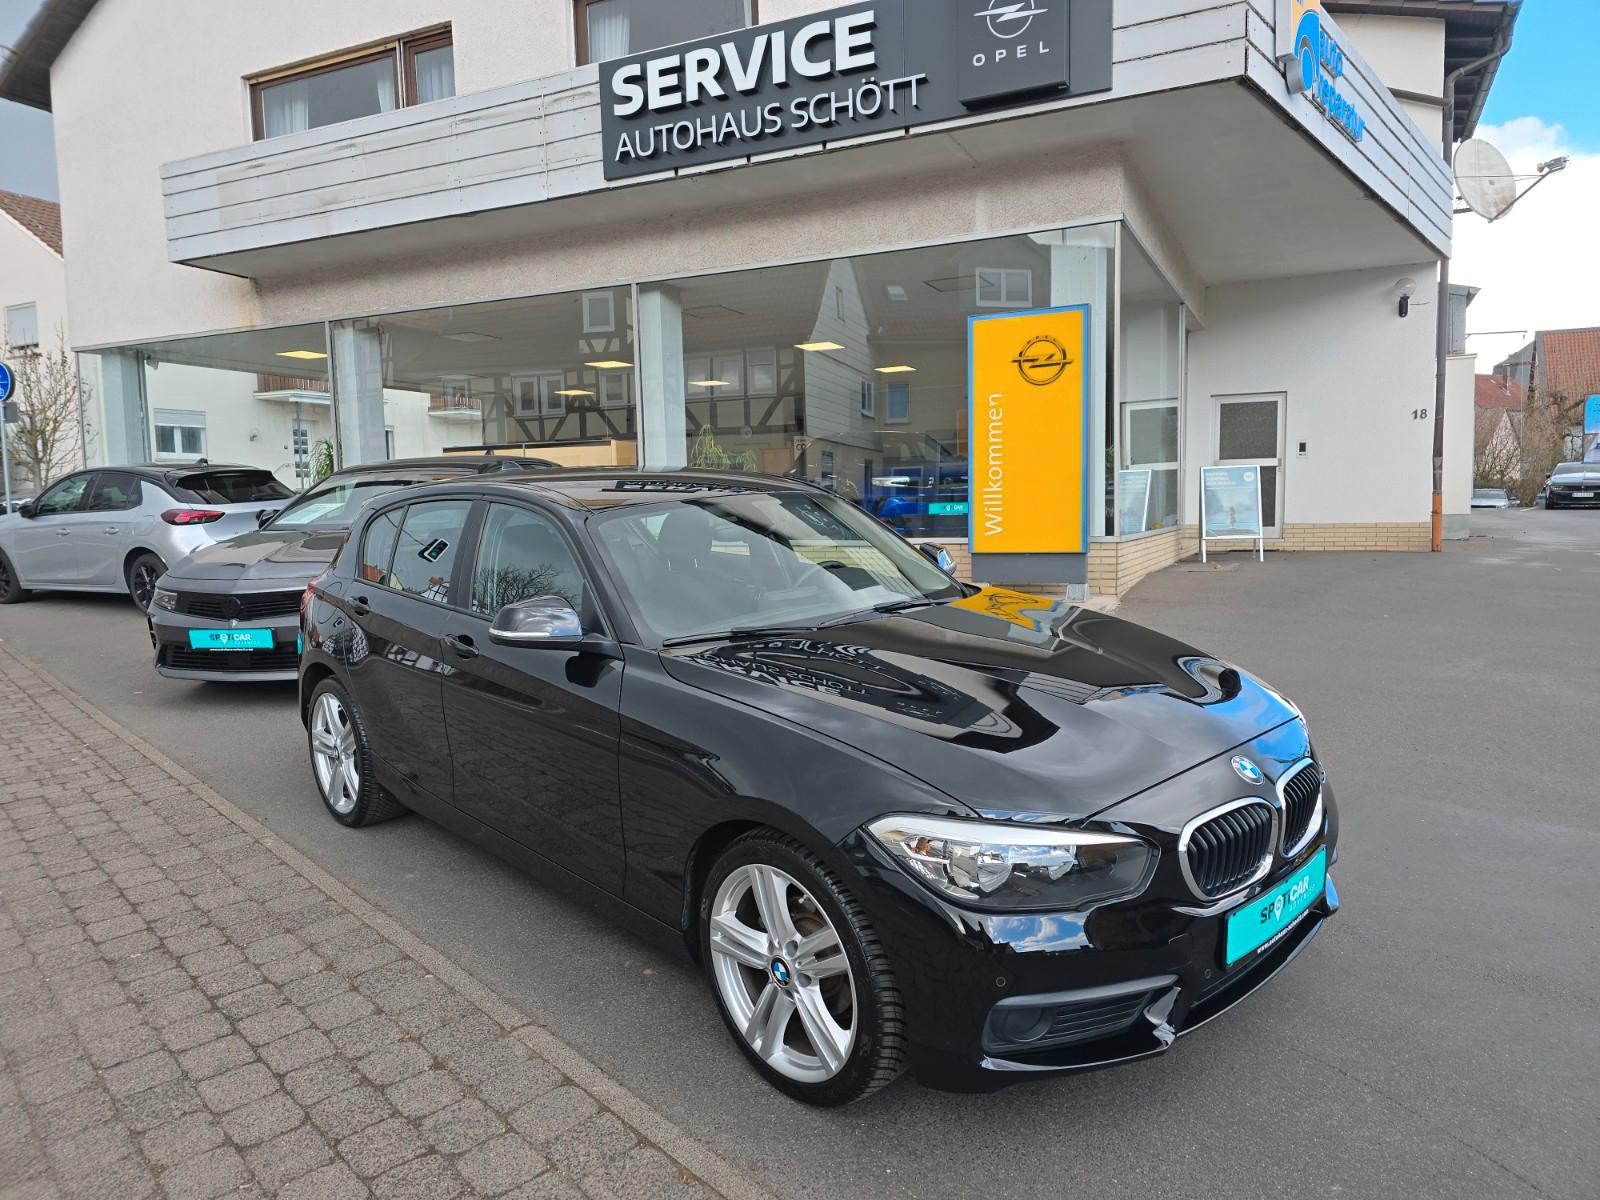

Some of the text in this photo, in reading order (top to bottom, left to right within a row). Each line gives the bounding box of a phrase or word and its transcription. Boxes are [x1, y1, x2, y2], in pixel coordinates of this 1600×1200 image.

[611, 10, 876, 116] SERVICE
[972, 40, 1050, 68] OPEL
[614, 73, 927, 162] AUTOHAUS SCHÖTT
[1410, 408, 1428, 420] 18
[983, 392, 1003, 537] Willkommen
